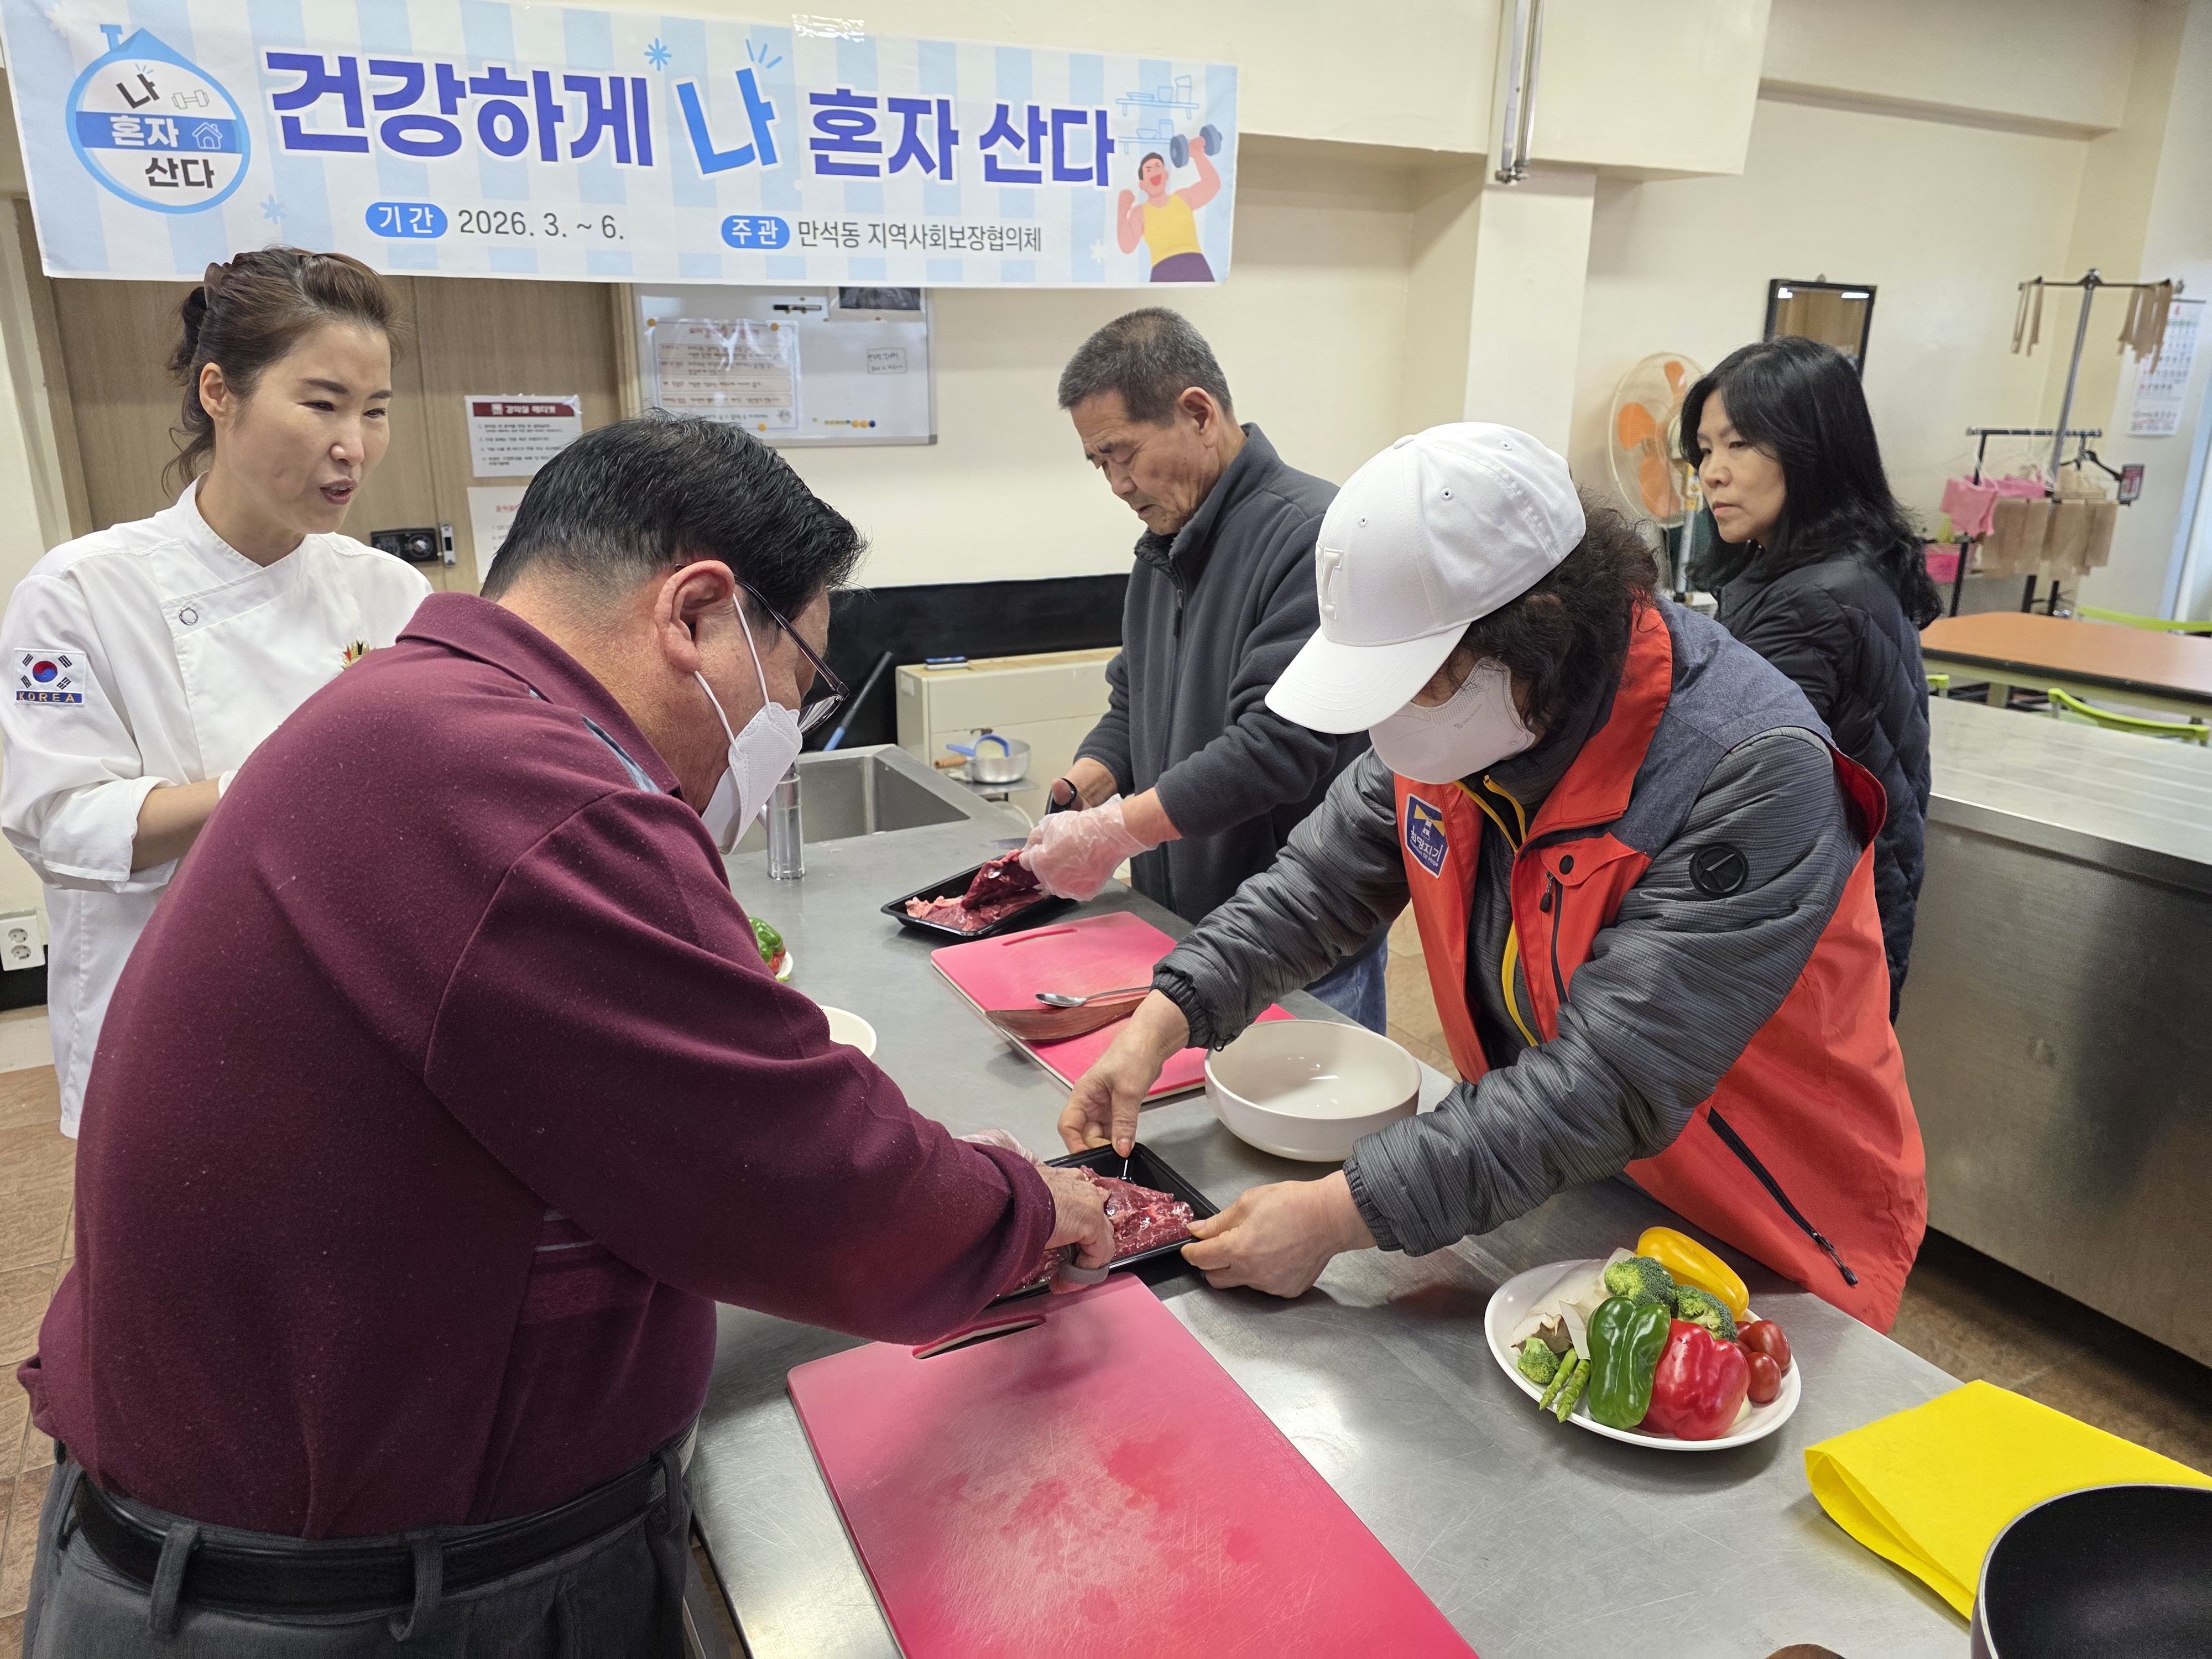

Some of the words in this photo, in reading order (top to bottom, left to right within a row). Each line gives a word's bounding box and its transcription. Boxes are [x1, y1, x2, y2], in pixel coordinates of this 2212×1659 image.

[116, 73, 160, 109] 나
[110, 115, 180, 148] 혼자
[266, 51, 654, 166] 건강하게
[676, 67, 778, 175] 나
[808, 88, 959, 181] 혼자
[979, 103, 1115, 187] 산다
[145, 157, 215, 189] 산다
[458, 210, 535, 237] 2026.
[543, 213, 567, 238] 3.
[601, 215, 624, 239] 6.
[798, 220, 860, 248] 만석동
[868, 222, 1042, 252] 지역사회보장협의체
[19, 691, 75, 702] KOREA
[1410, 825, 1443, 862] 희망지기
